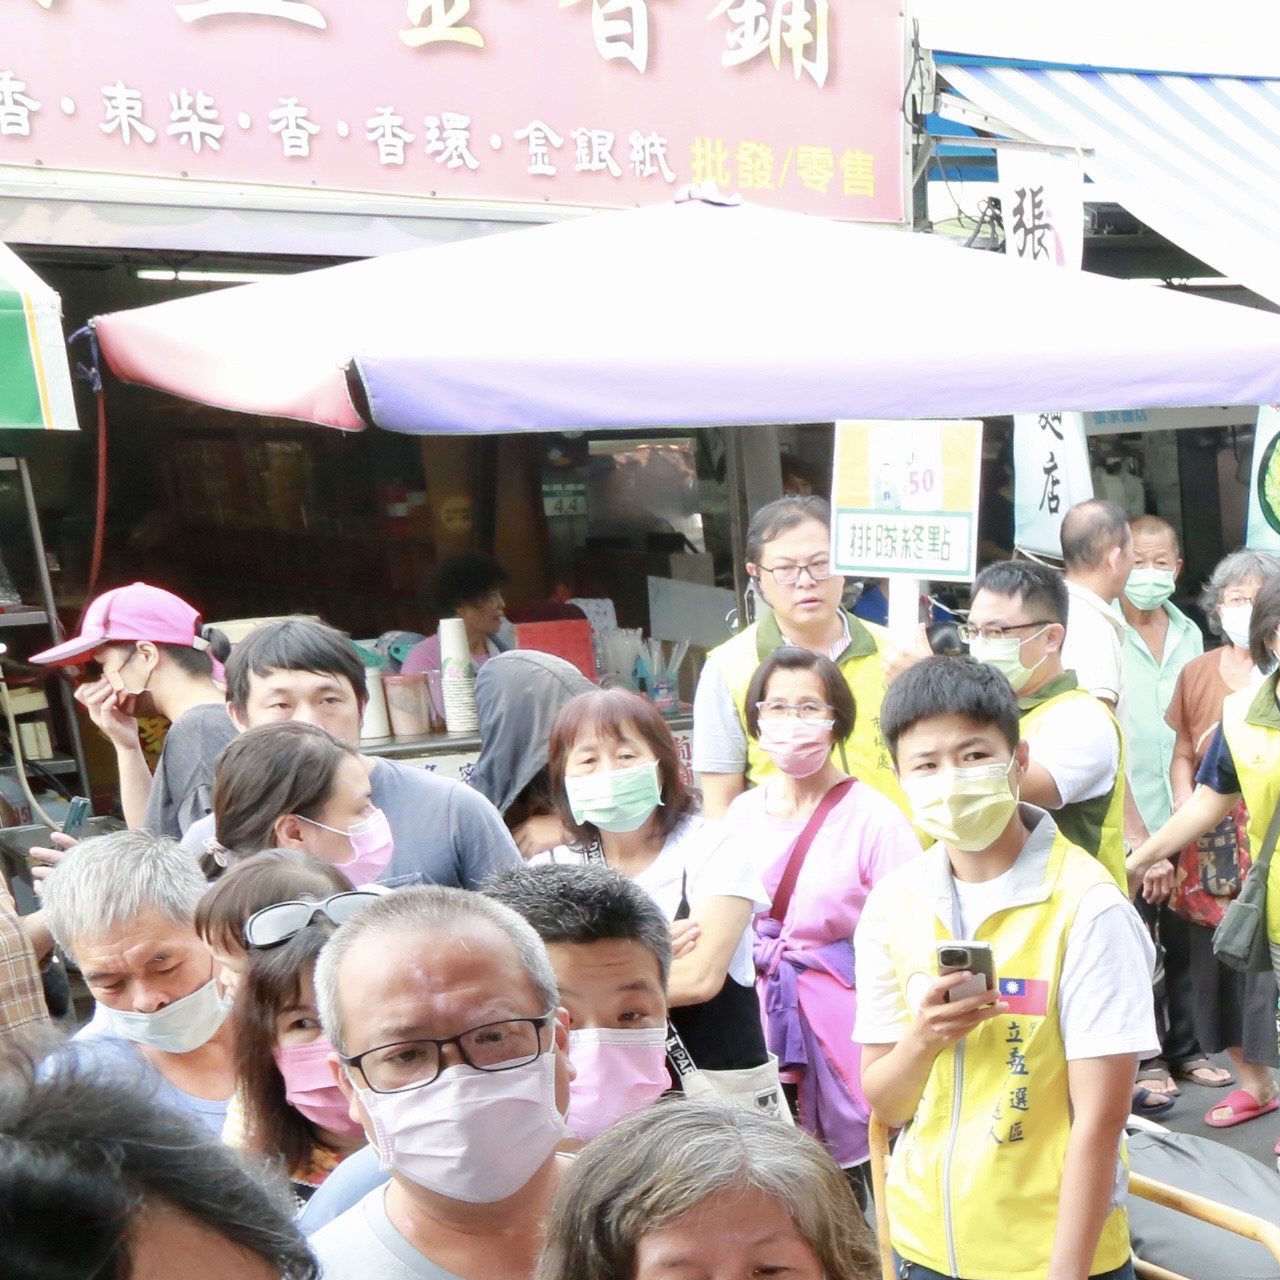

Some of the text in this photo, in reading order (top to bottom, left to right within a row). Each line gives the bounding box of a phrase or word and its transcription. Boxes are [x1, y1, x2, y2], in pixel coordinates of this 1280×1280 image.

[690, 136, 876, 198] 批發/零售
[1012, 185, 1053, 261] 張
